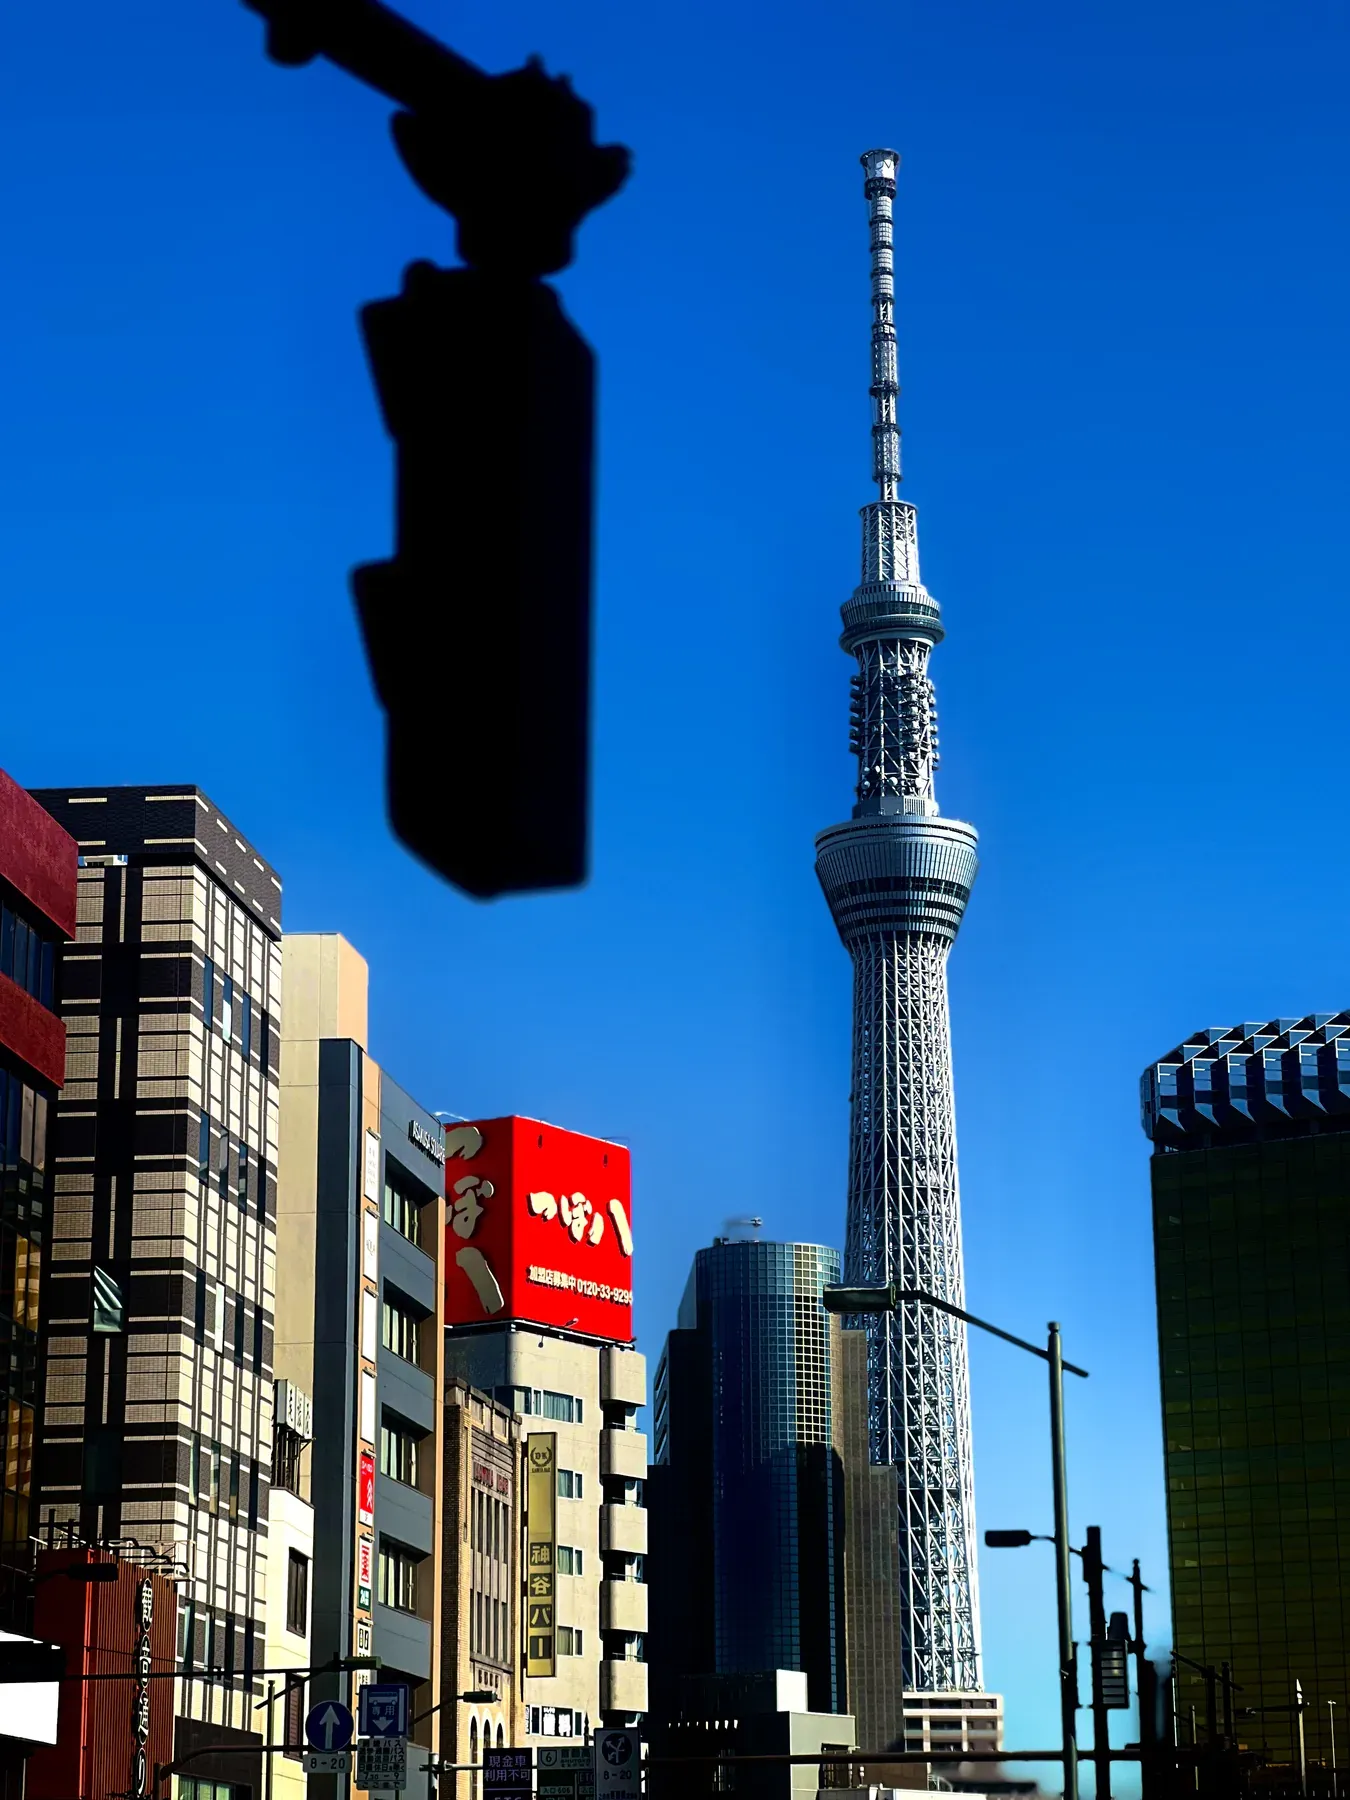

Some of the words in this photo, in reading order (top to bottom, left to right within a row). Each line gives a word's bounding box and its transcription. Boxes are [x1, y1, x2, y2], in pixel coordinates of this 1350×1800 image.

[528, 1191, 634, 1257] つぼ八
[528, 1264, 577, 1291] 加盟店募集中
[531, 1544, 551, 1657] 神谷バー
[371, 1705, 395, 1716] 専用
[488, 1754, 527, 1768] 現金車
[545, 1751, 552, 1763] 6
[484, 1768, 531, 1782] 利用不可
